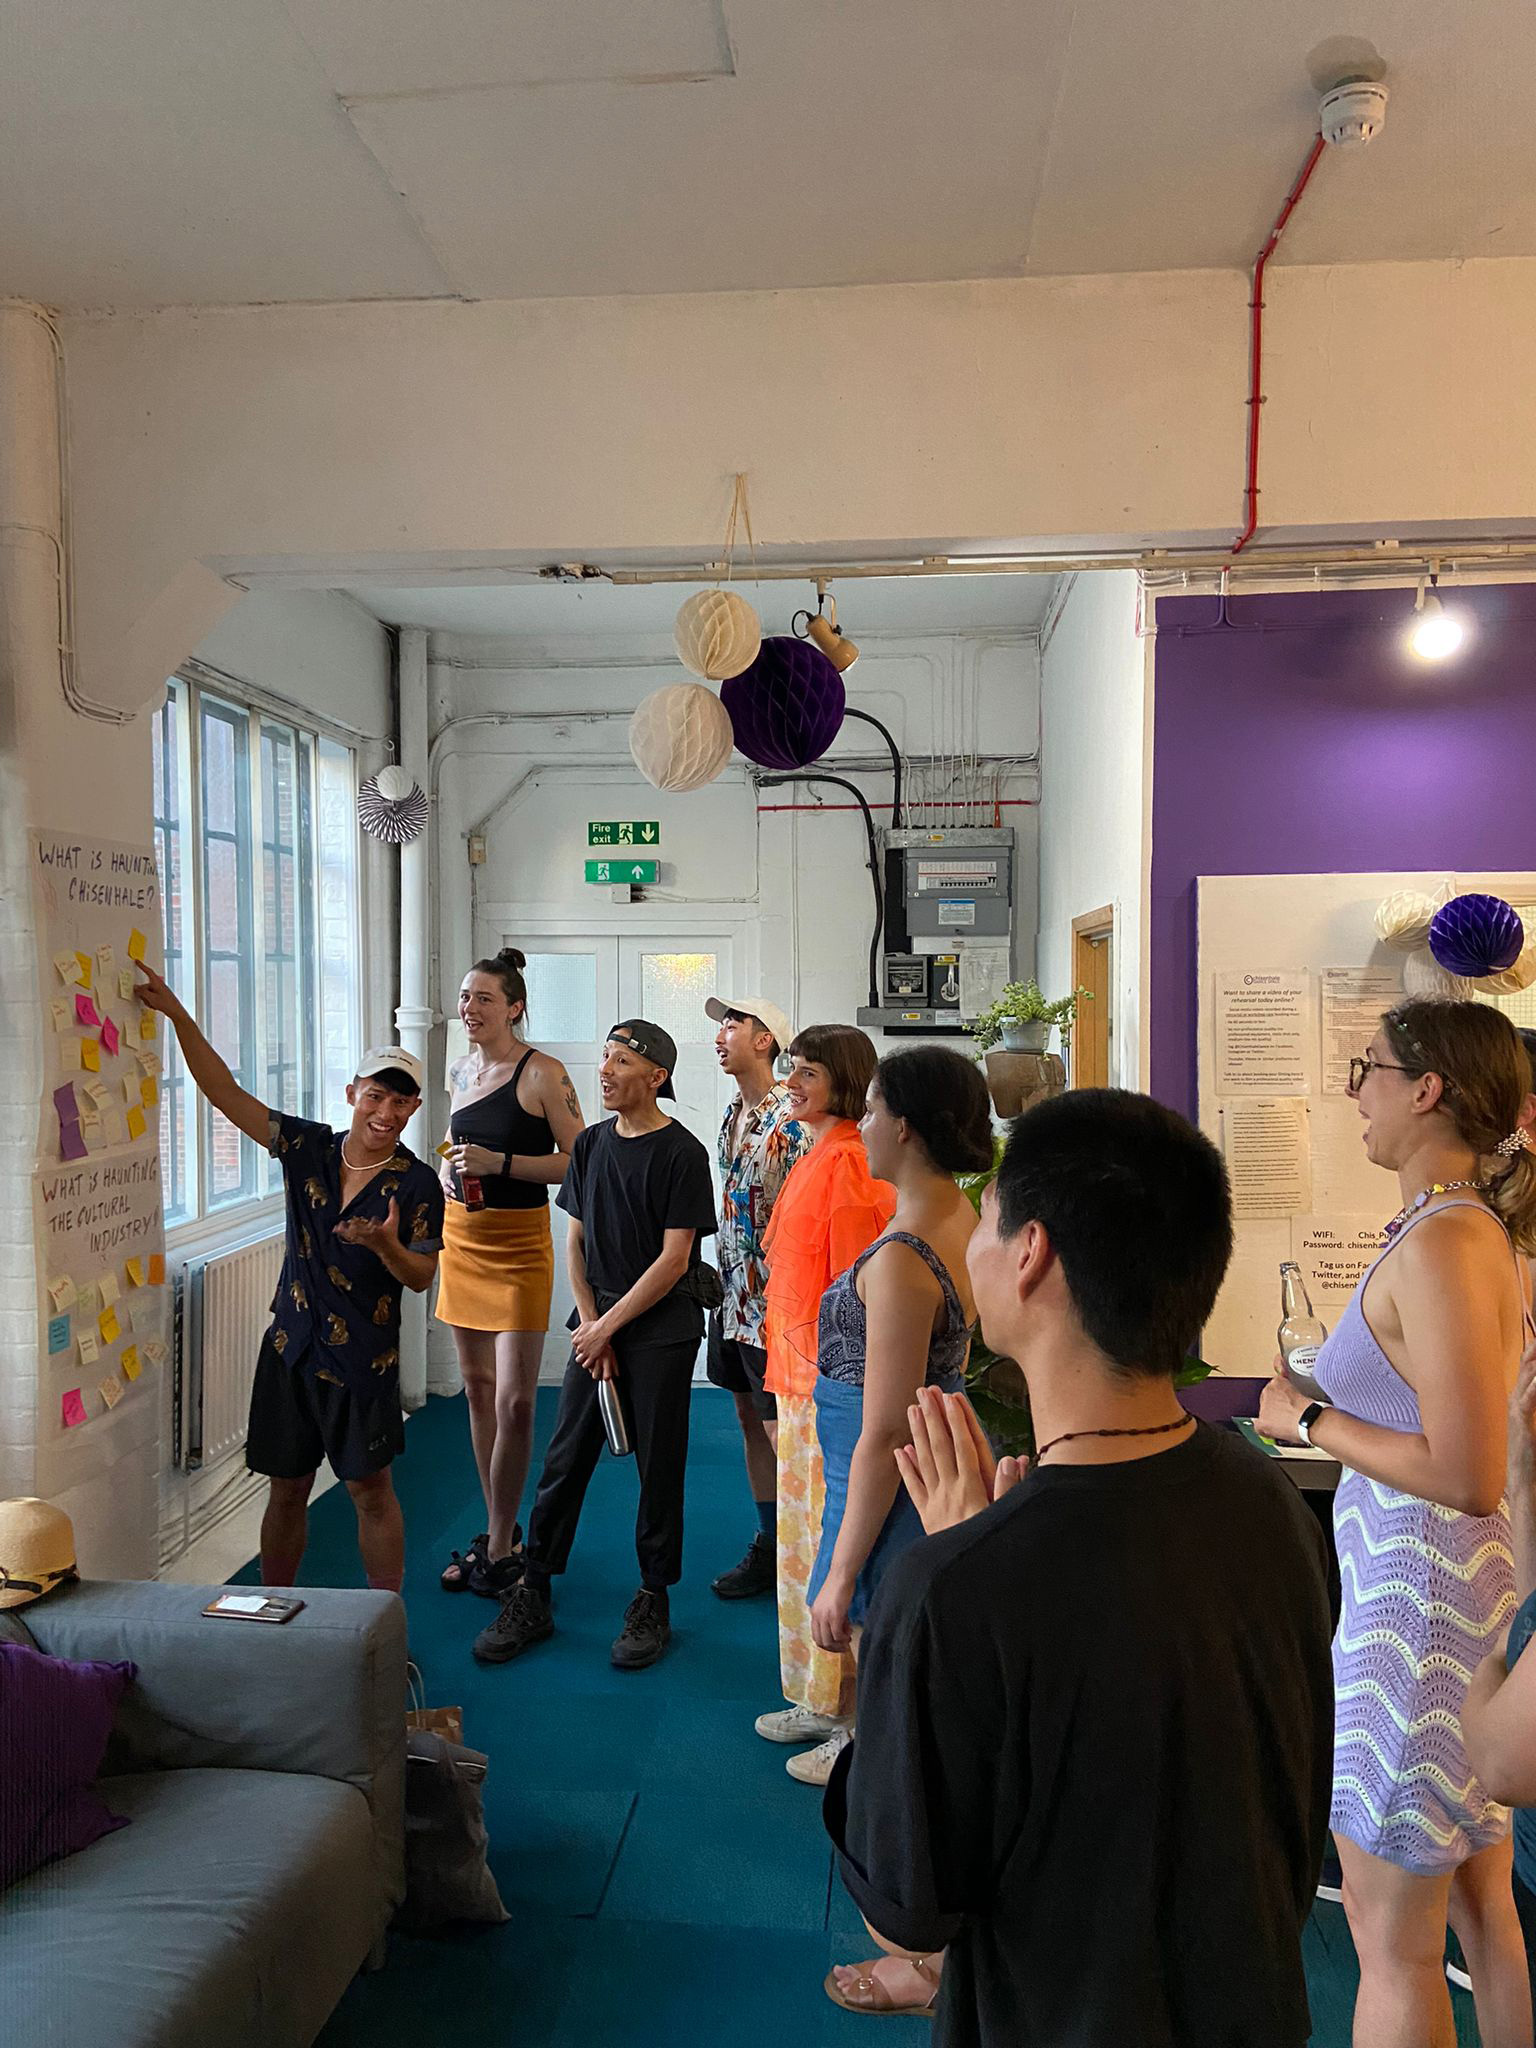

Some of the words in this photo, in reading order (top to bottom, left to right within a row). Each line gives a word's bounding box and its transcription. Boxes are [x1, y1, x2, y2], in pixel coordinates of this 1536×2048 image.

[592, 823, 611, 832] Fire
[592, 834, 611, 843] exit
[38, 841, 82, 870] WHAT
[42, 1173, 83, 1203] WHAT
[49, 1210, 73, 1233] THE
[77, 1194, 131, 1228] CULTURAL
[1358, 1232, 1389, 1240] Chis_Pu
[1303, 1240, 1344, 1248] Password:
[1319, 1261, 1334, 1270] Tag
[1312, 1271, 1344, 1279] Twitter,
